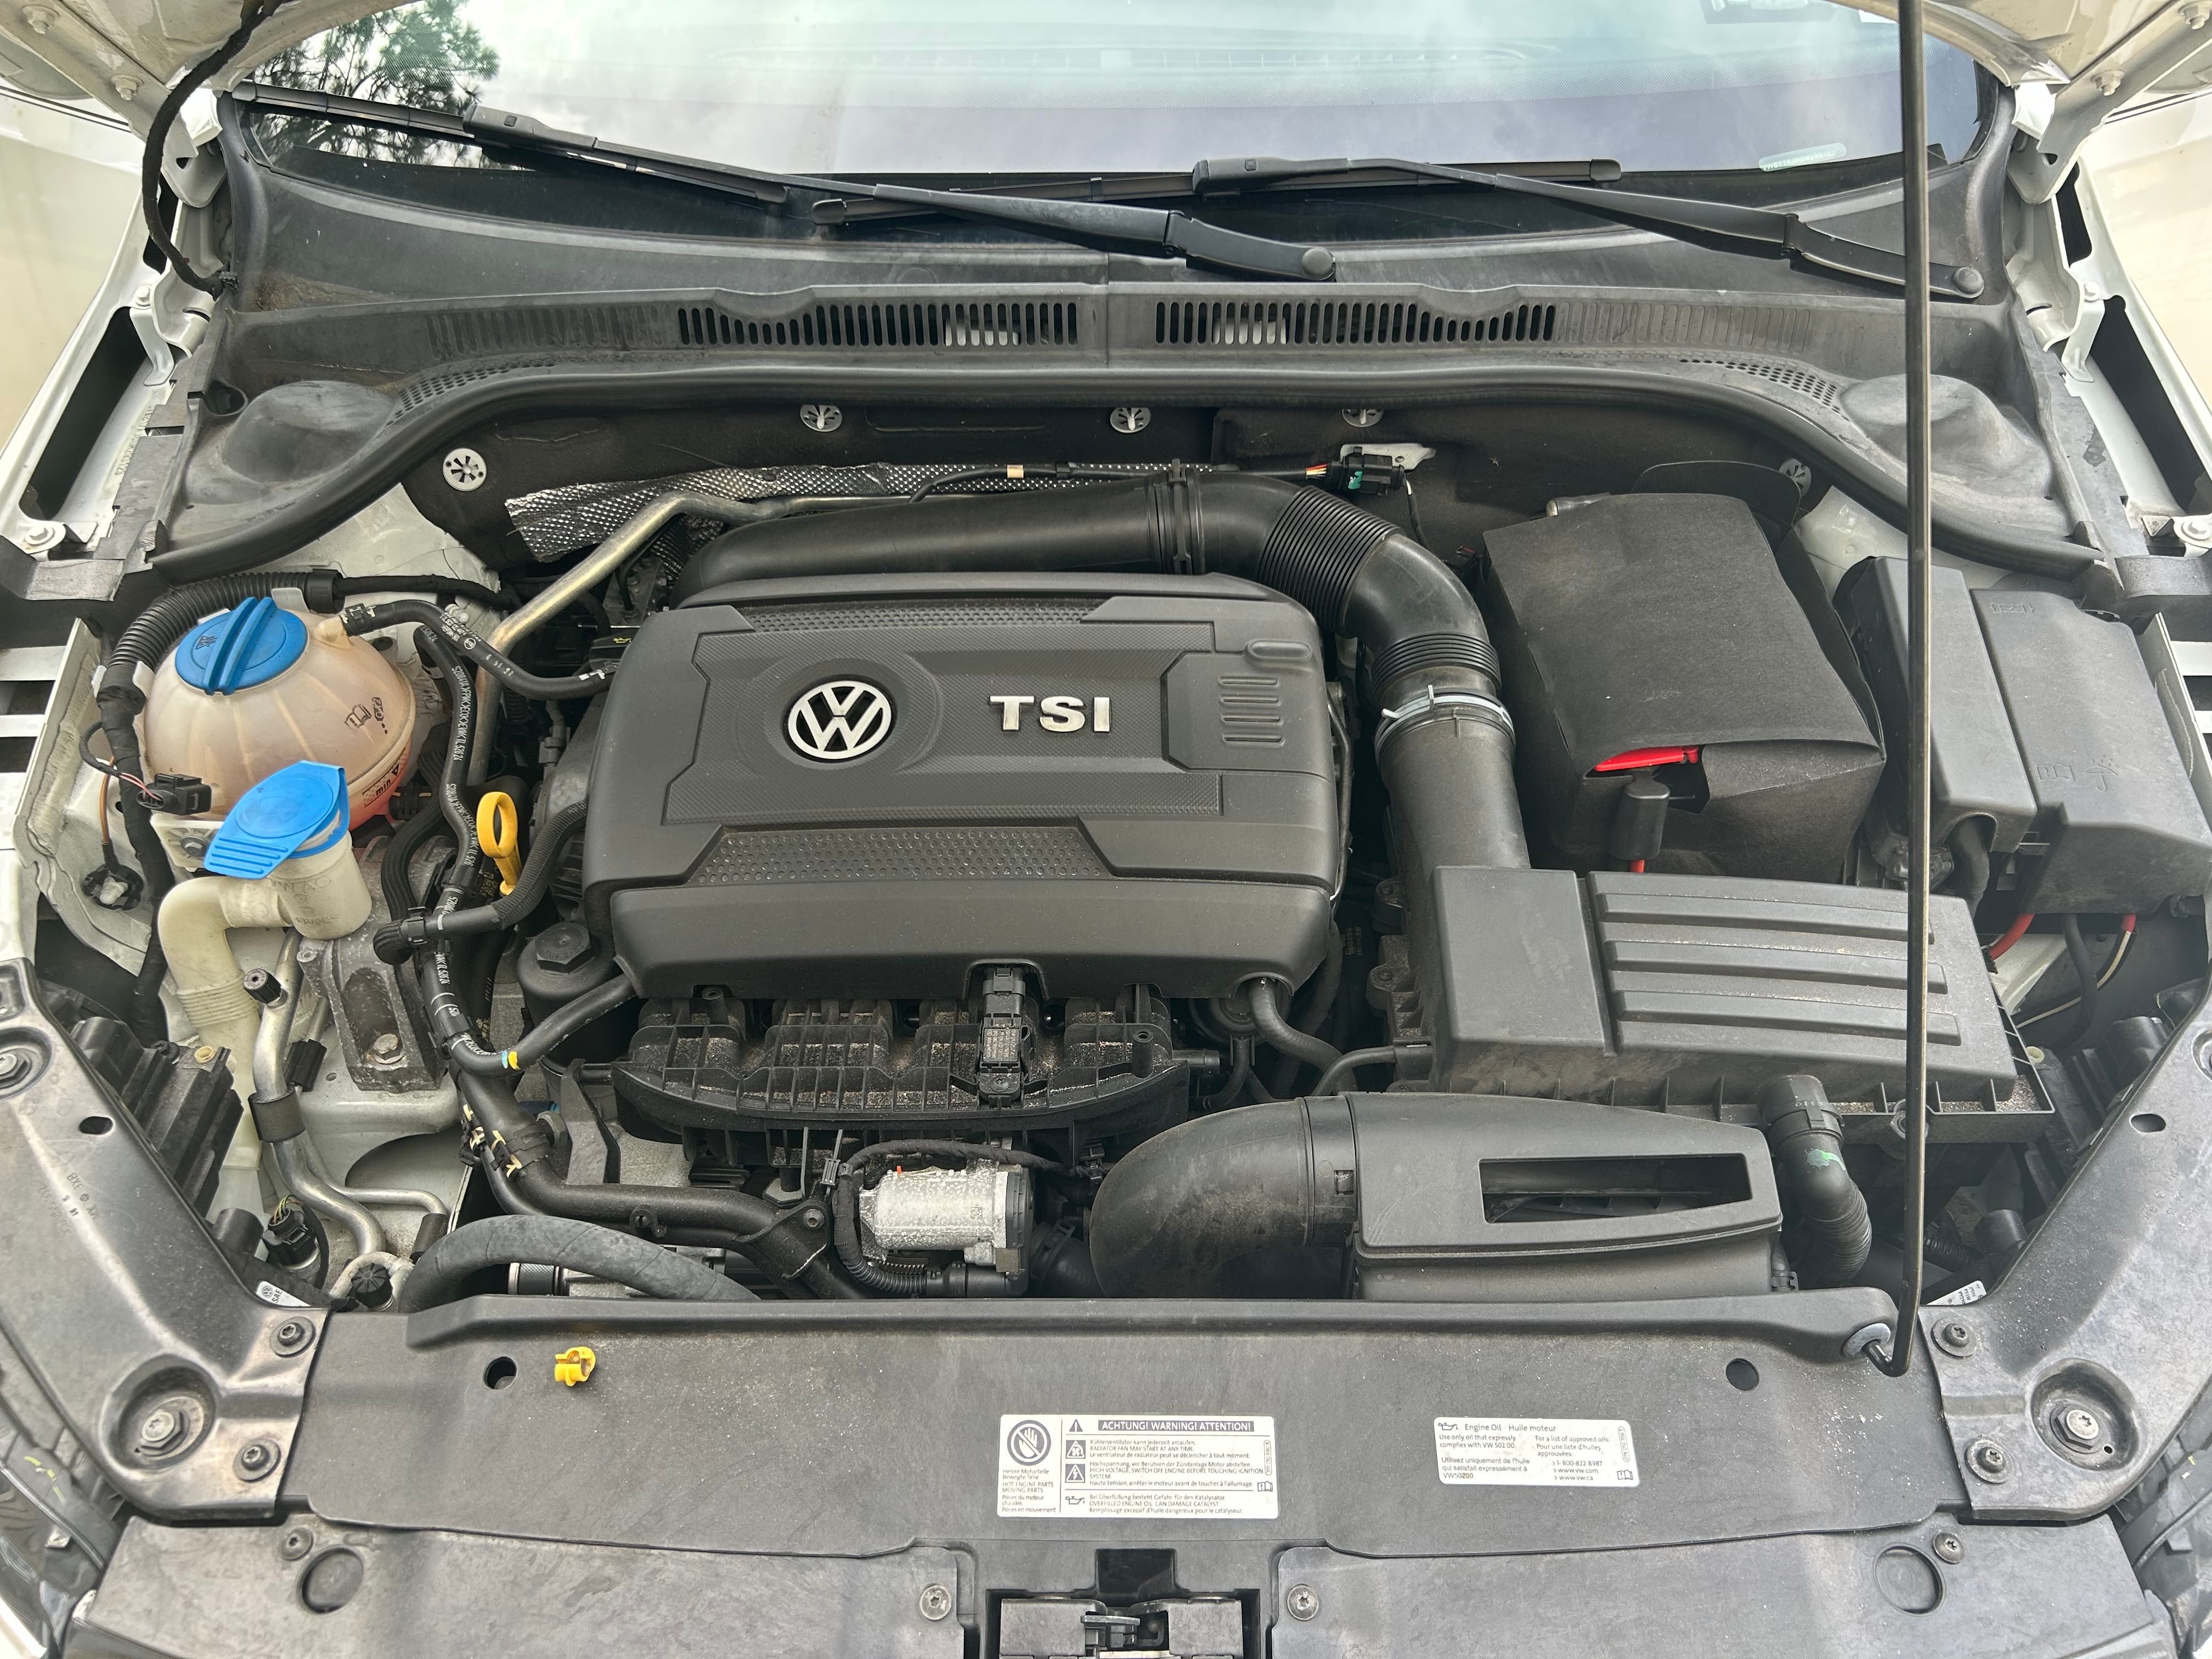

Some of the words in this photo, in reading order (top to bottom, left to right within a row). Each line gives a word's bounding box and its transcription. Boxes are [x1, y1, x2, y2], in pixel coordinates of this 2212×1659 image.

[990, 696, 1110, 732] TSI
[376, 779, 391, 796] min
[272, 1289, 283, 1304] SAE
[1102, 1421, 1148, 1430] ACHTUNG!
[1151, 1421, 1197, 1430] WARNING!
[1199, 1422, 1251, 1431] ATTENTION!
[1465, 1424, 1489, 1432] Engine
